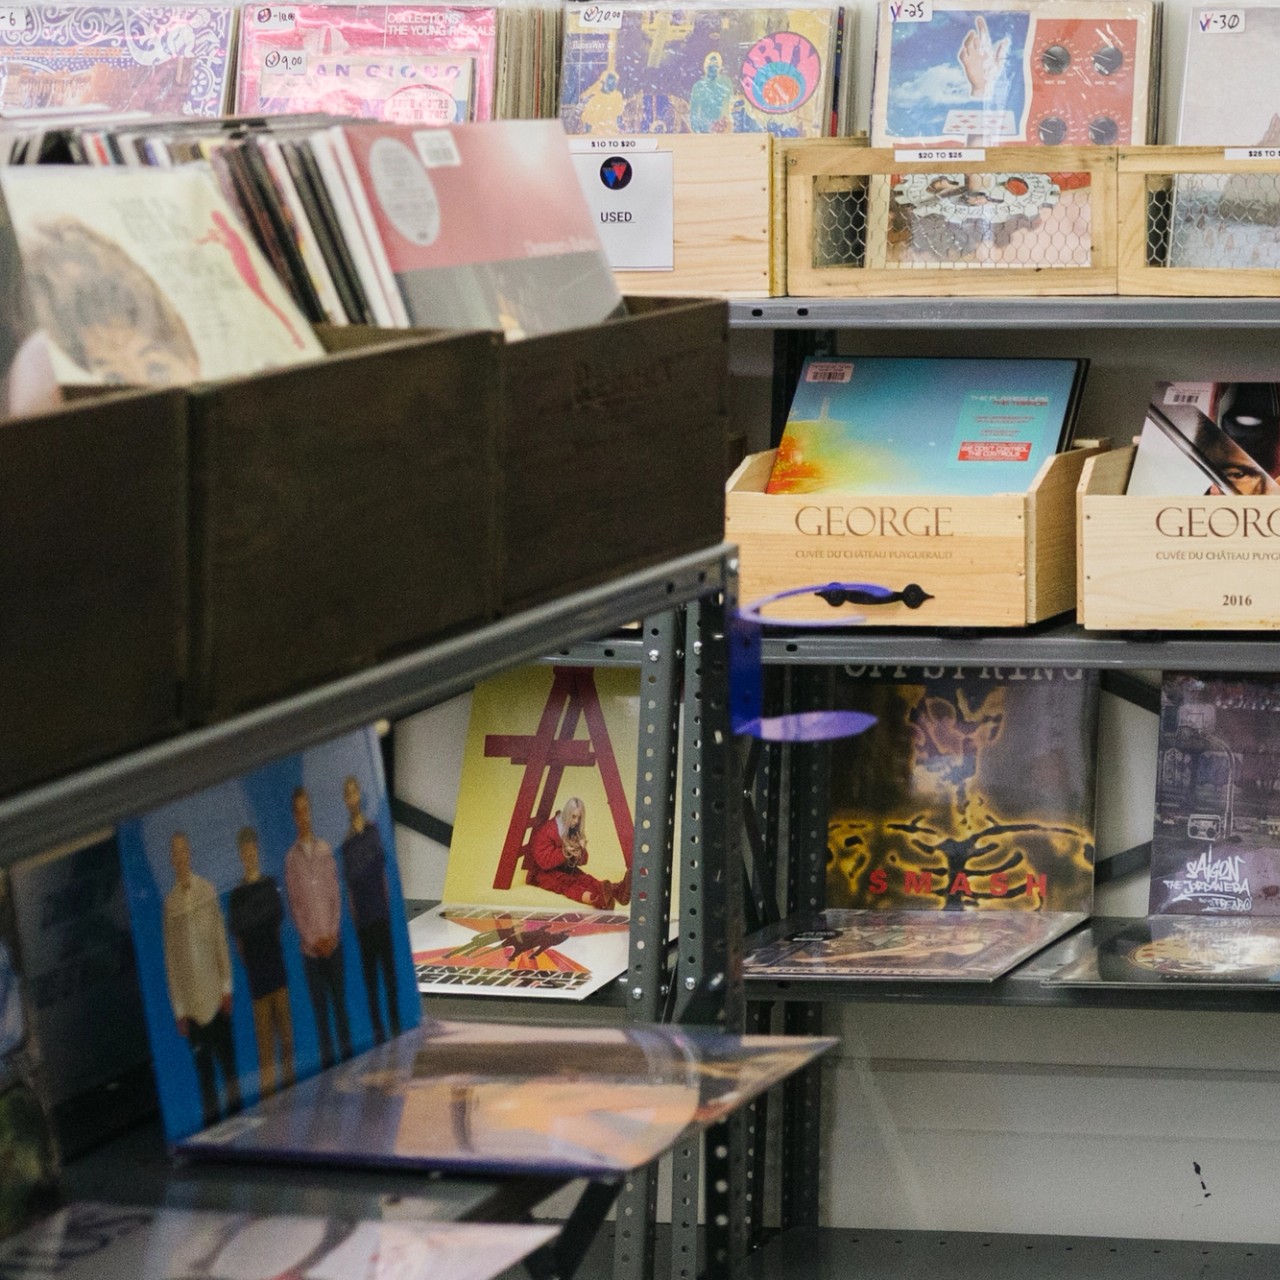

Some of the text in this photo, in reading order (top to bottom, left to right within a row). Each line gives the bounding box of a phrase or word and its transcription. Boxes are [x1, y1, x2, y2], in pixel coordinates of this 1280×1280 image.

[388, 25, 408, 36] THE
[410, 25, 446, 36] YOUNG
[591, 140, 636, 148] $10 TO $20
[918, 151, 963, 159] $20 TO $25
[600, 211, 632, 223] USED
[795, 505, 954, 537] GEORGE
[795, 548, 825, 559] CUVÉE
[826, 549, 841, 559] DU
[843, 548, 887, 559] CHÂTEAU
[1156, 550, 1187, 561] CUVÉE
[1188, 551, 1203, 561] DU
[1205, 549, 1250, 561] CHÂTEAU
[1222, 594, 1253, 607] 2016
[868, 871, 1048, 897] SMASH
